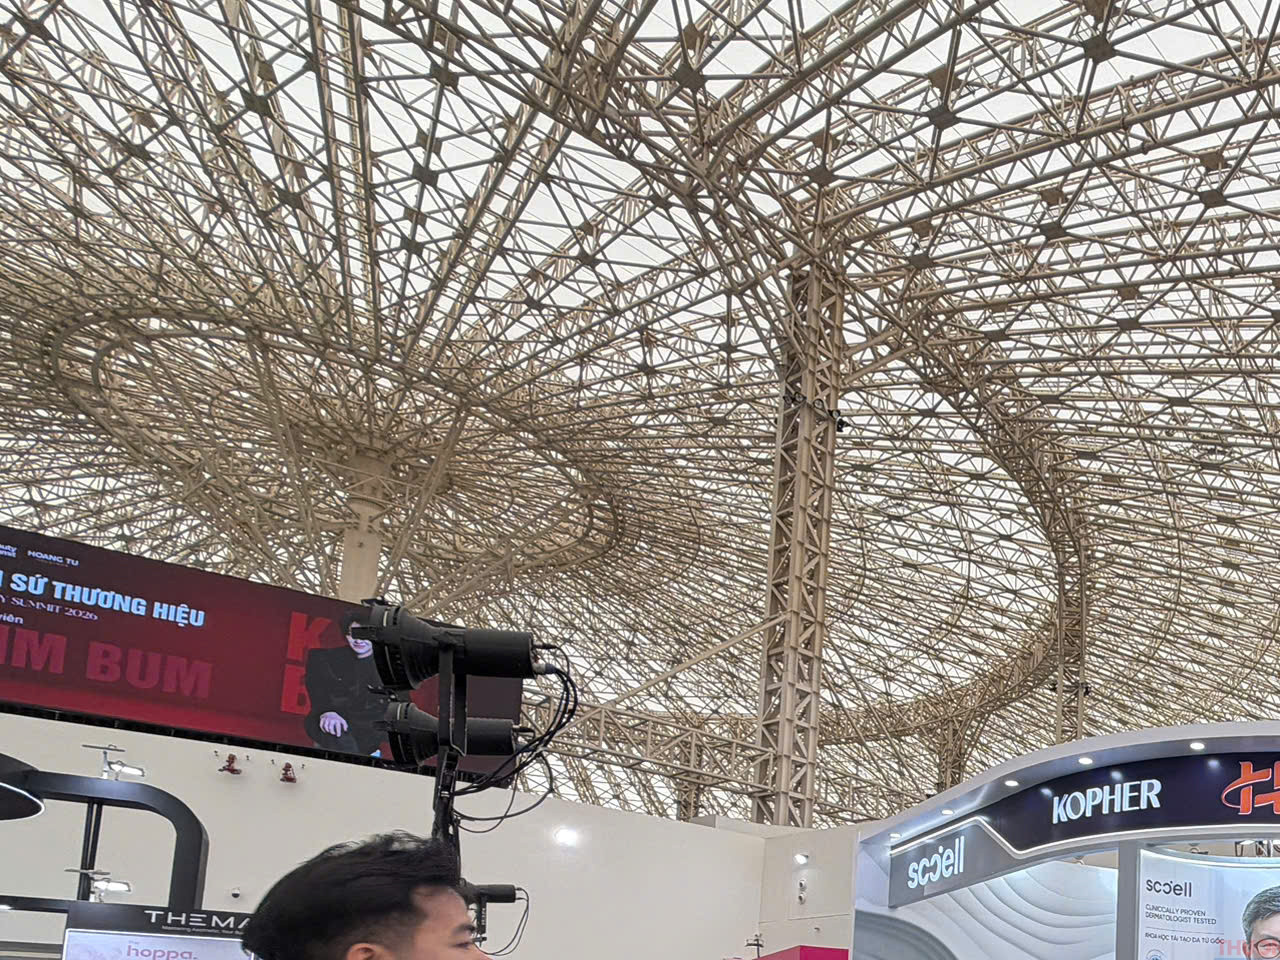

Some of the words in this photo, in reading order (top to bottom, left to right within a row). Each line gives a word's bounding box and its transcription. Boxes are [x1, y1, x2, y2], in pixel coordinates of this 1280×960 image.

[27, 550, 64, 563] HOANG
[65, 558, 80, 566] TU
[9, 573, 49, 595] SỨ
[52, 581, 148, 616] THƯƠNG
[152, 601, 206, 628] HIỆU
[64, 607, 99, 620] 2026
[86, 640, 213, 699] BUM
[1052, 778, 1162, 824] KOPHER
[1145, 911, 1192, 924] DERMATOLOGIST
[1193, 917, 1217, 925] TESTED
[1180, 908, 1206, 916] PROVEN
[126, 944, 198, 960] hoppa.
